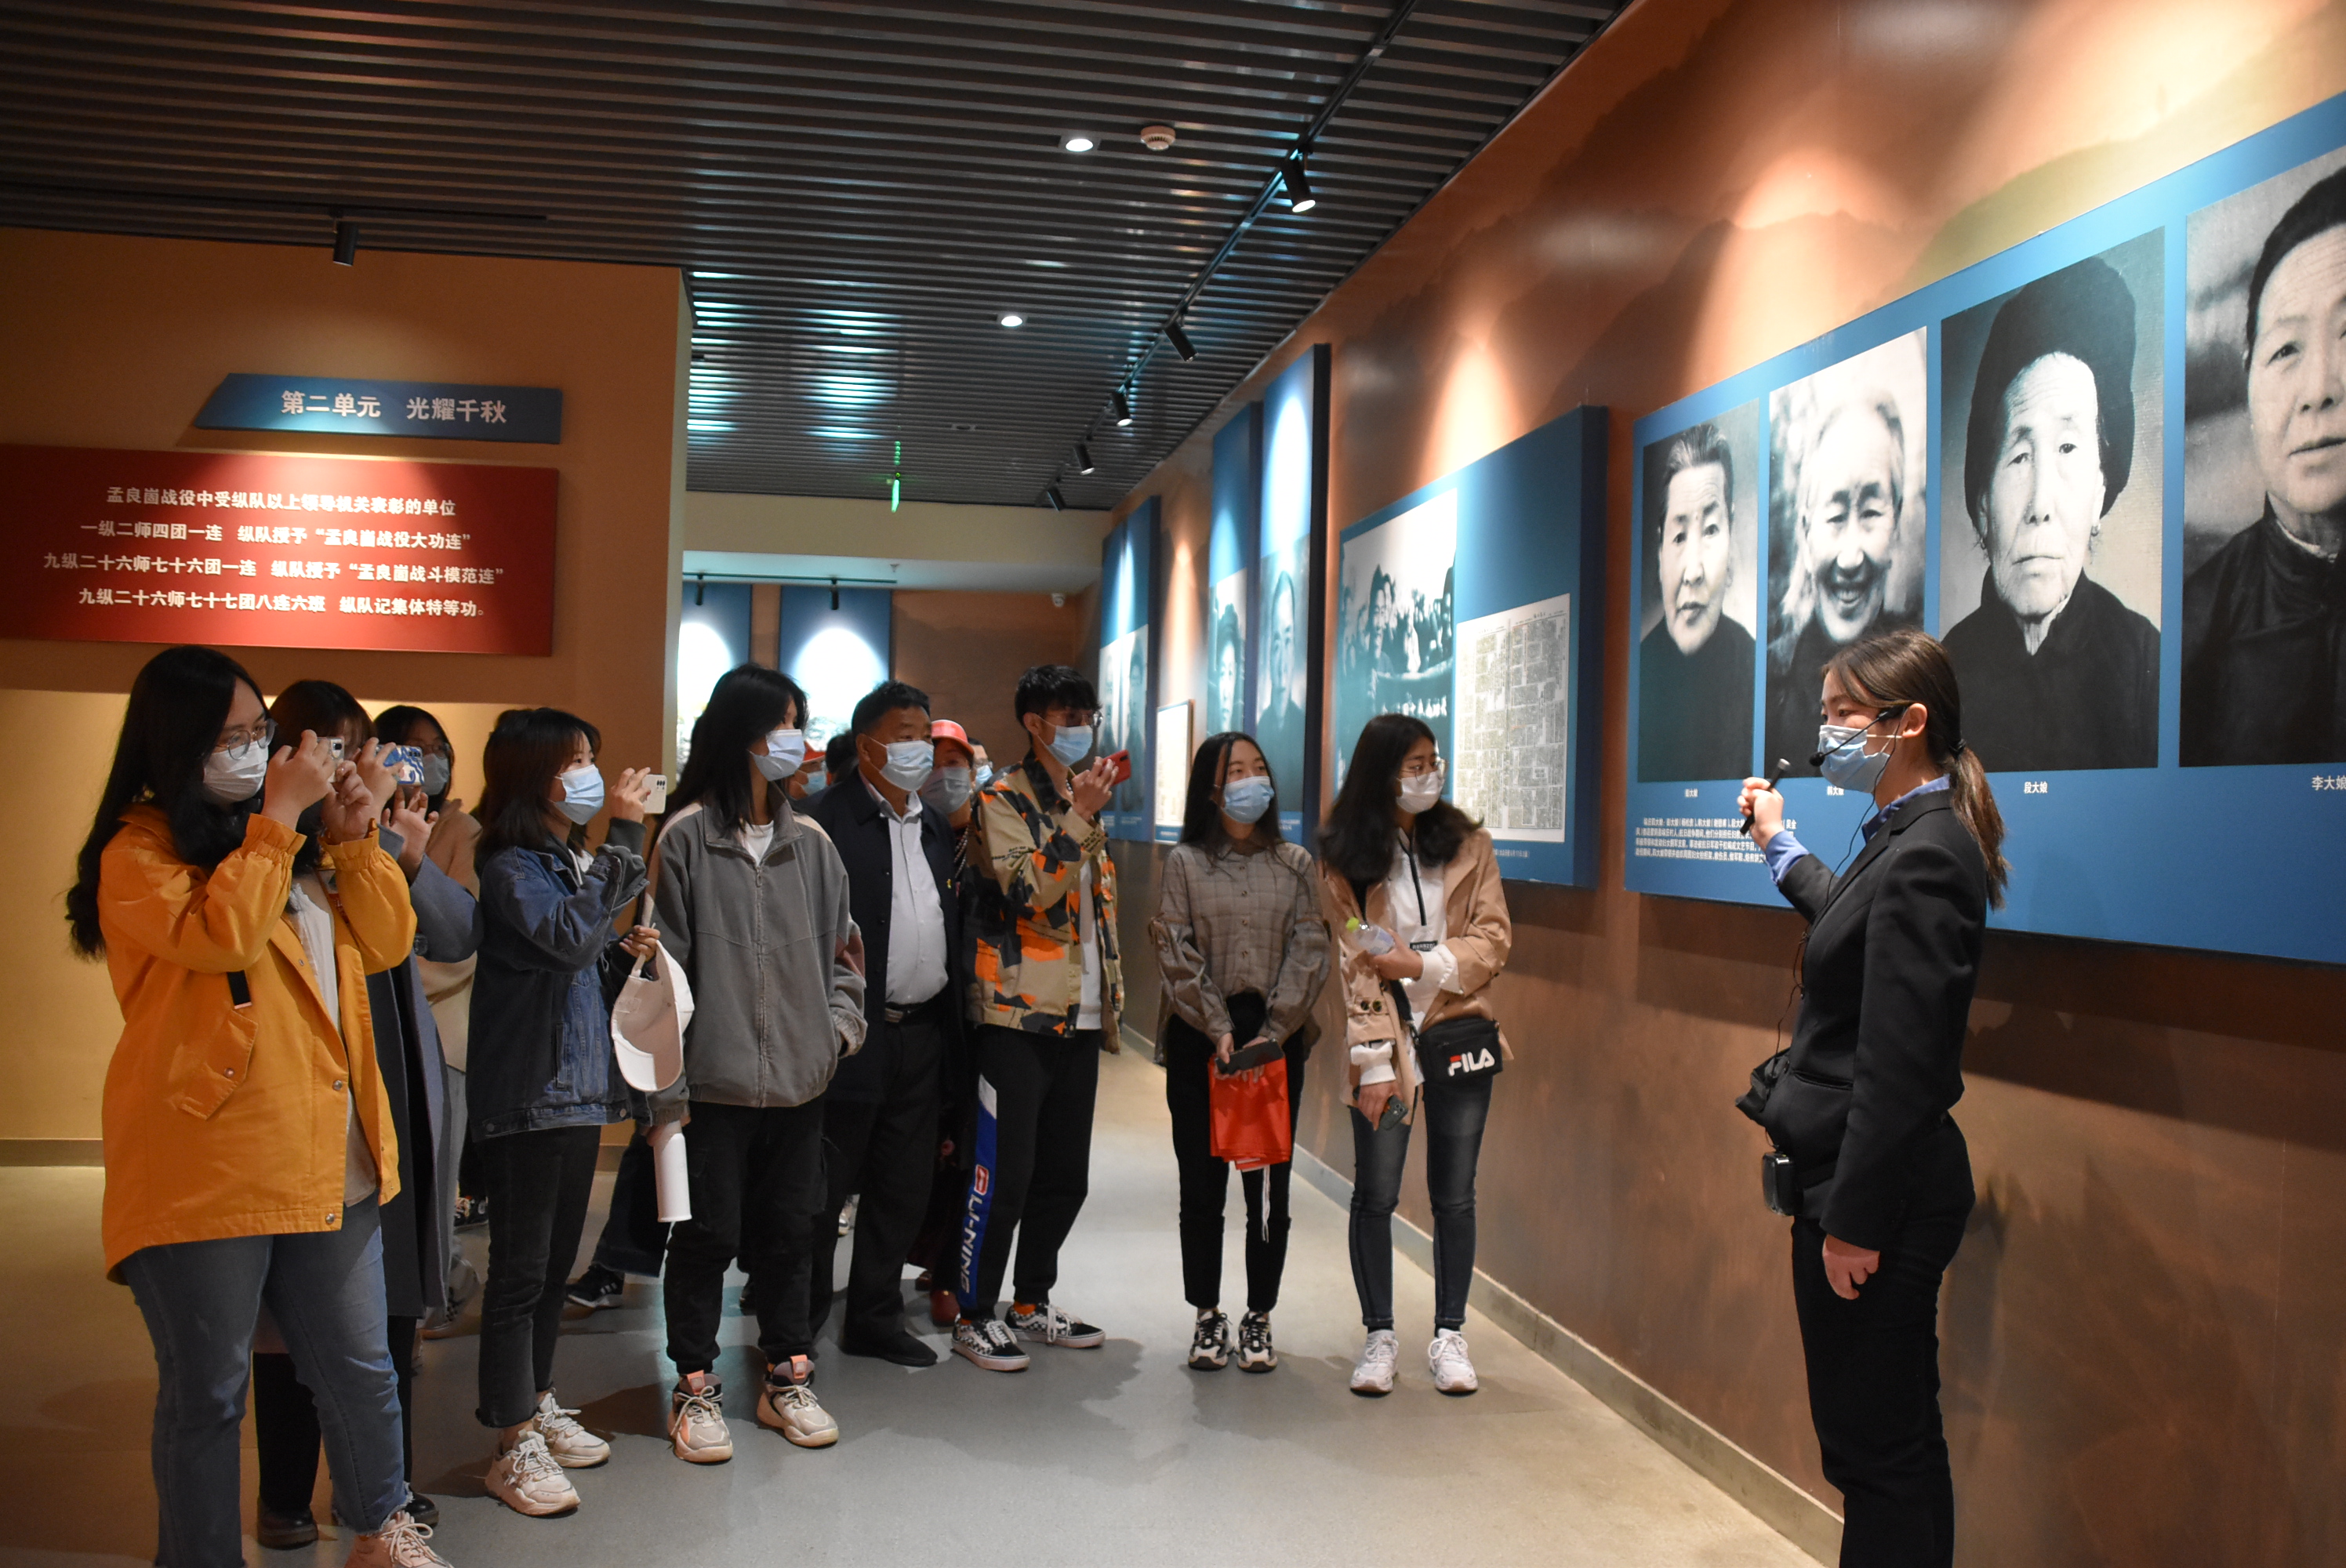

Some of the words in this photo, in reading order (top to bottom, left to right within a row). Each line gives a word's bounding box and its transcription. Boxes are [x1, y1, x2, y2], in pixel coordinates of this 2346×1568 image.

[281, 390, 381, 418] 第二单元
[406, 396, 507, 423] 光耀千秋
[107, 486, 456, 517] 孟良崮战役中受纵队以上领导机关表彰的单位
[81, 521, 223, 541] 一纵二师四团一连
[237, 525, 307, 545] 纵队授予
[44, 552, 256, 576] 九纵二十六师七十六团一连
[271, 560, 341, 579] 纵队授予
[79, 587, 326, 612] 九纵二十六师七十七团八连六班
[2024, 781, 2048, 793] 段大娘
[2312, 775, 2346, 791] 李大娘
[1447, 1047, 1495, 1076] FILA
[961, 1194, 983, 1294] LI-NING
